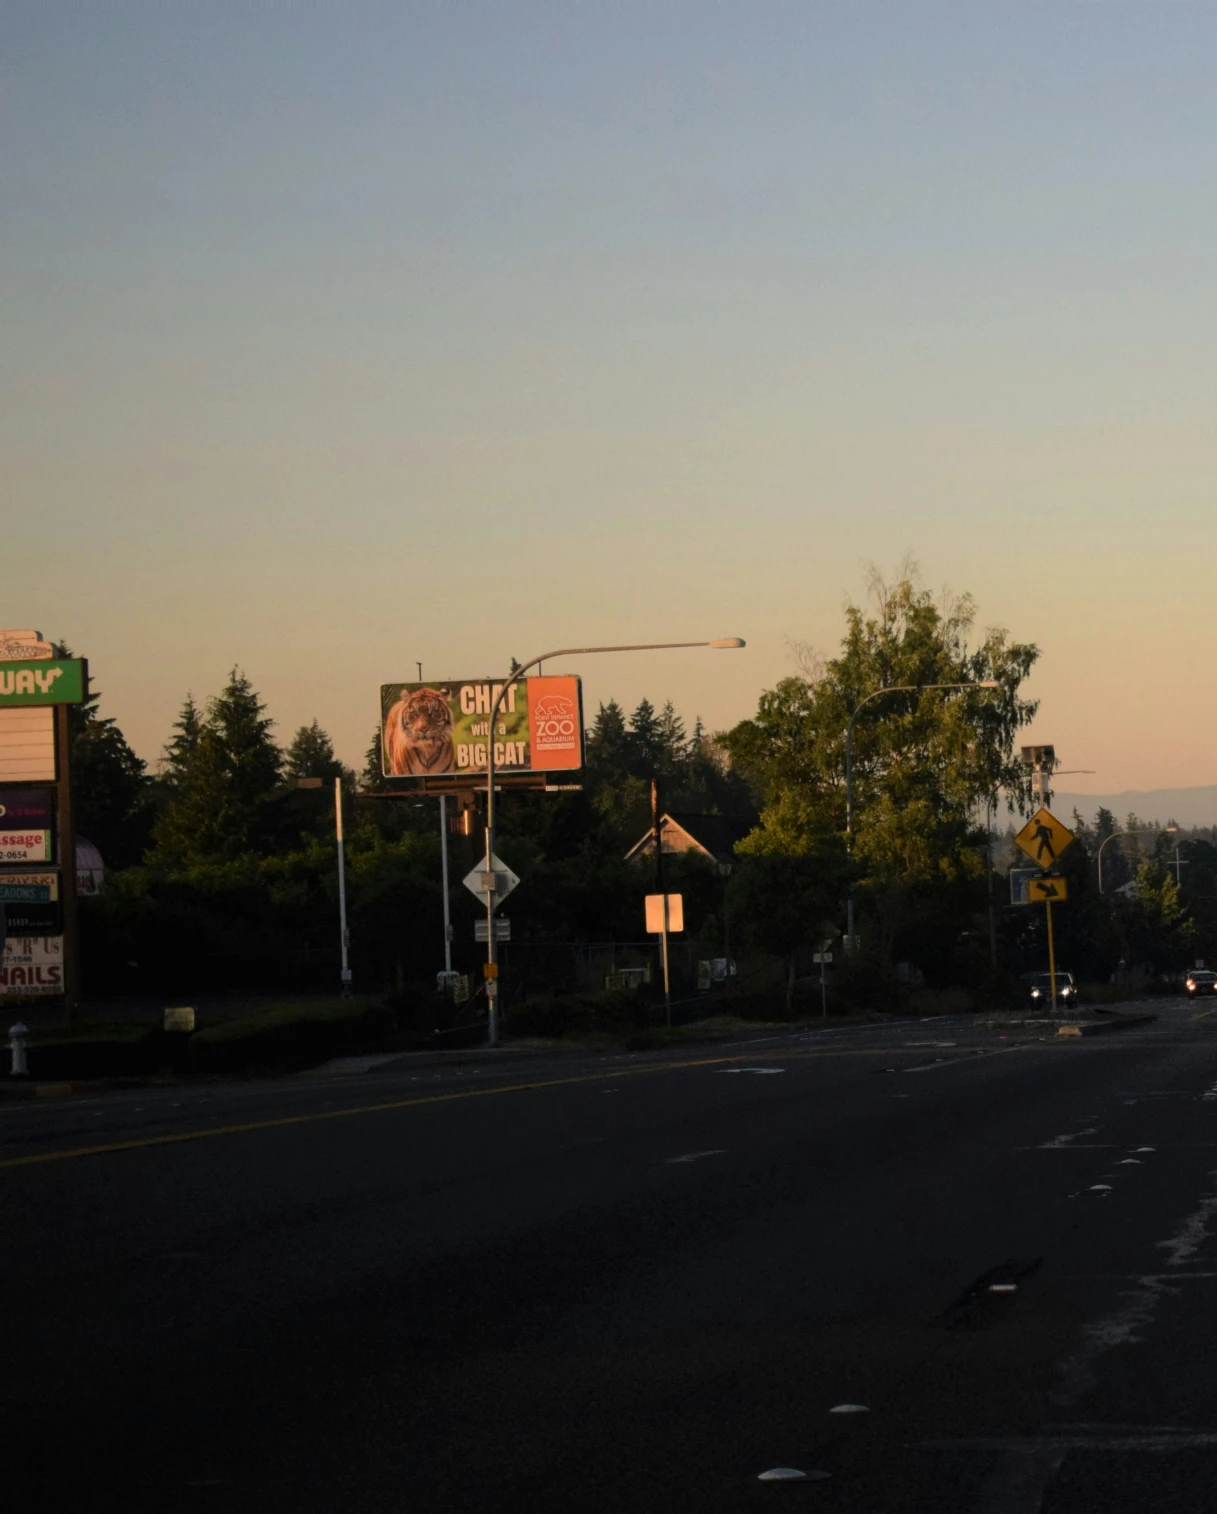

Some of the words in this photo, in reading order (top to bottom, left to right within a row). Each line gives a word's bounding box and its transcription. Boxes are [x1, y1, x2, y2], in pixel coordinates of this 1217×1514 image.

[460, 684, 517, 714] CHAT
[471, 721, 494, 736] wit
[499, 722, 506, 735] a
[536, 720, 574, 736] ZOO
[457, 743, 488, 767] BIG
[493, 741, 526, 765] CAT
[0, 835, 42, 848] ssage
